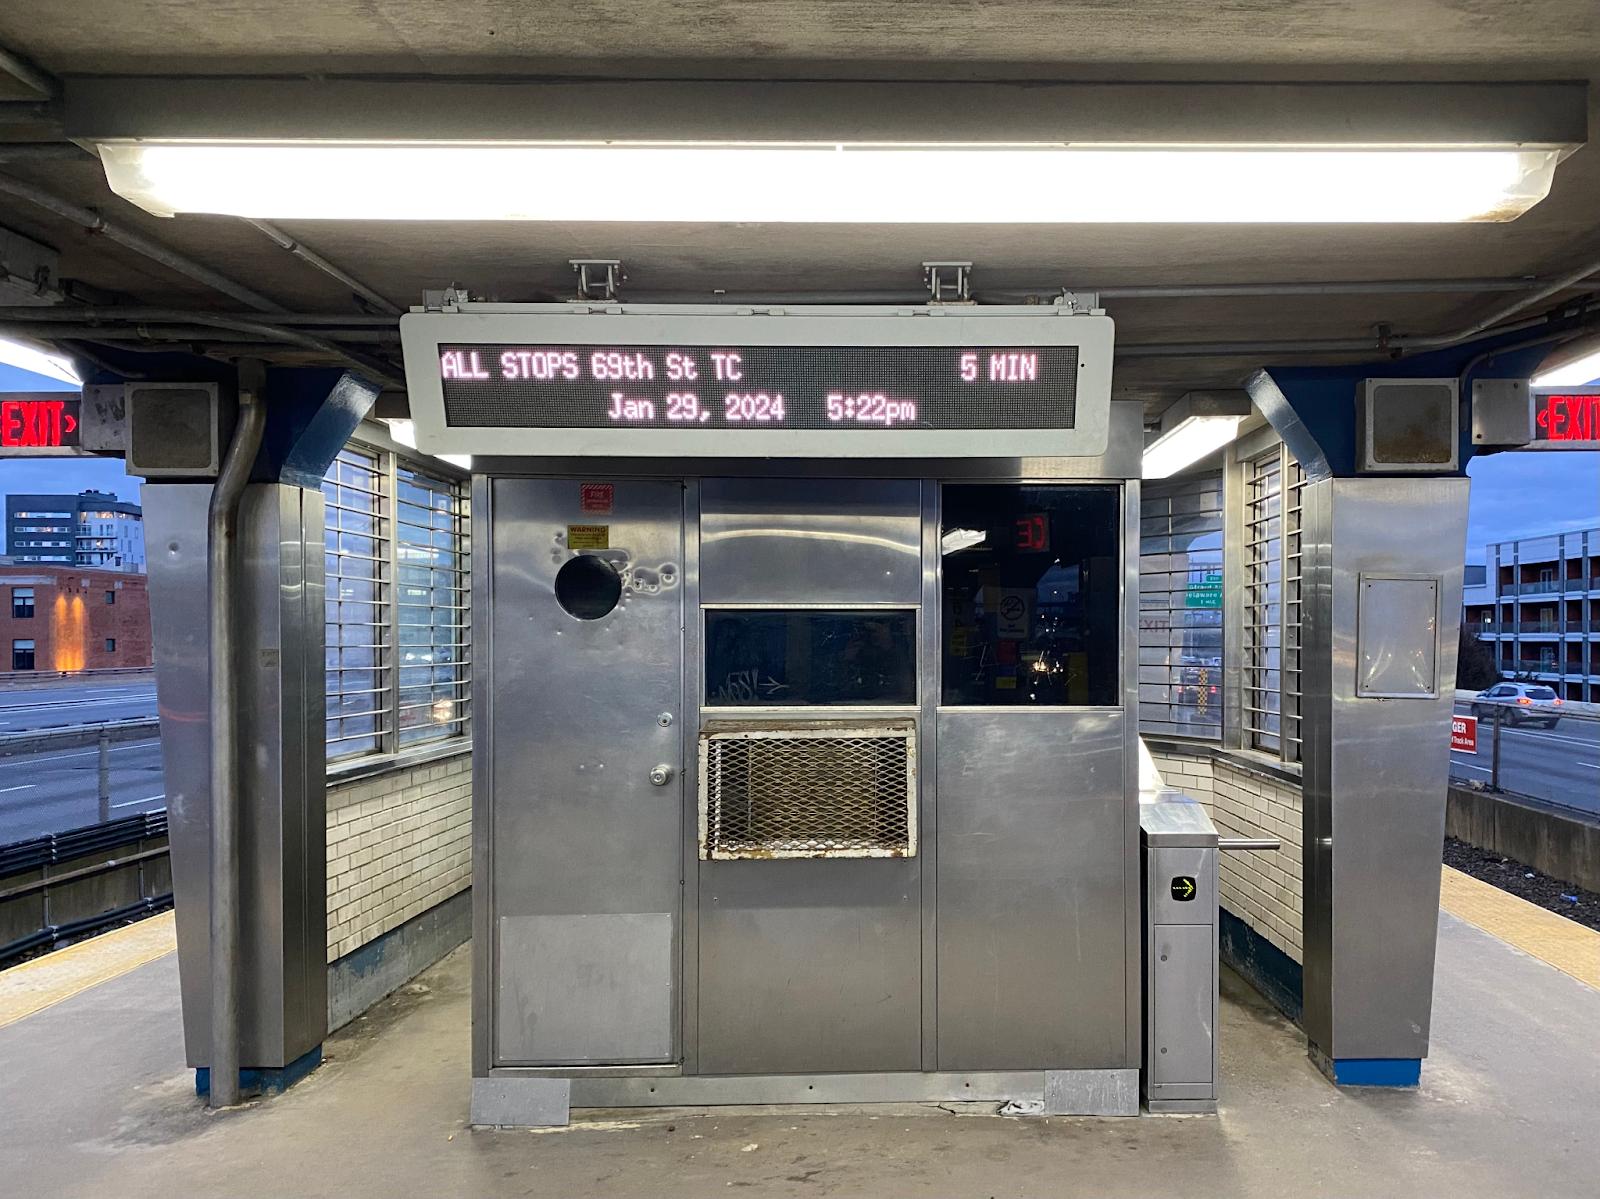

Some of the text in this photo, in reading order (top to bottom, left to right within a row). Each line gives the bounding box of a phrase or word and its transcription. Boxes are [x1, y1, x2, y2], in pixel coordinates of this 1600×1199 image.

[441, 351, 743, 382] ALL STOPS 69th St TC
[961, 353, 1037, 382] 5 MIN
[608, 394, 786, 423] Jan 29, 2024
[826, 395, 917, 425] 5:22pm
[1, 401, 65, 447] EXIT
